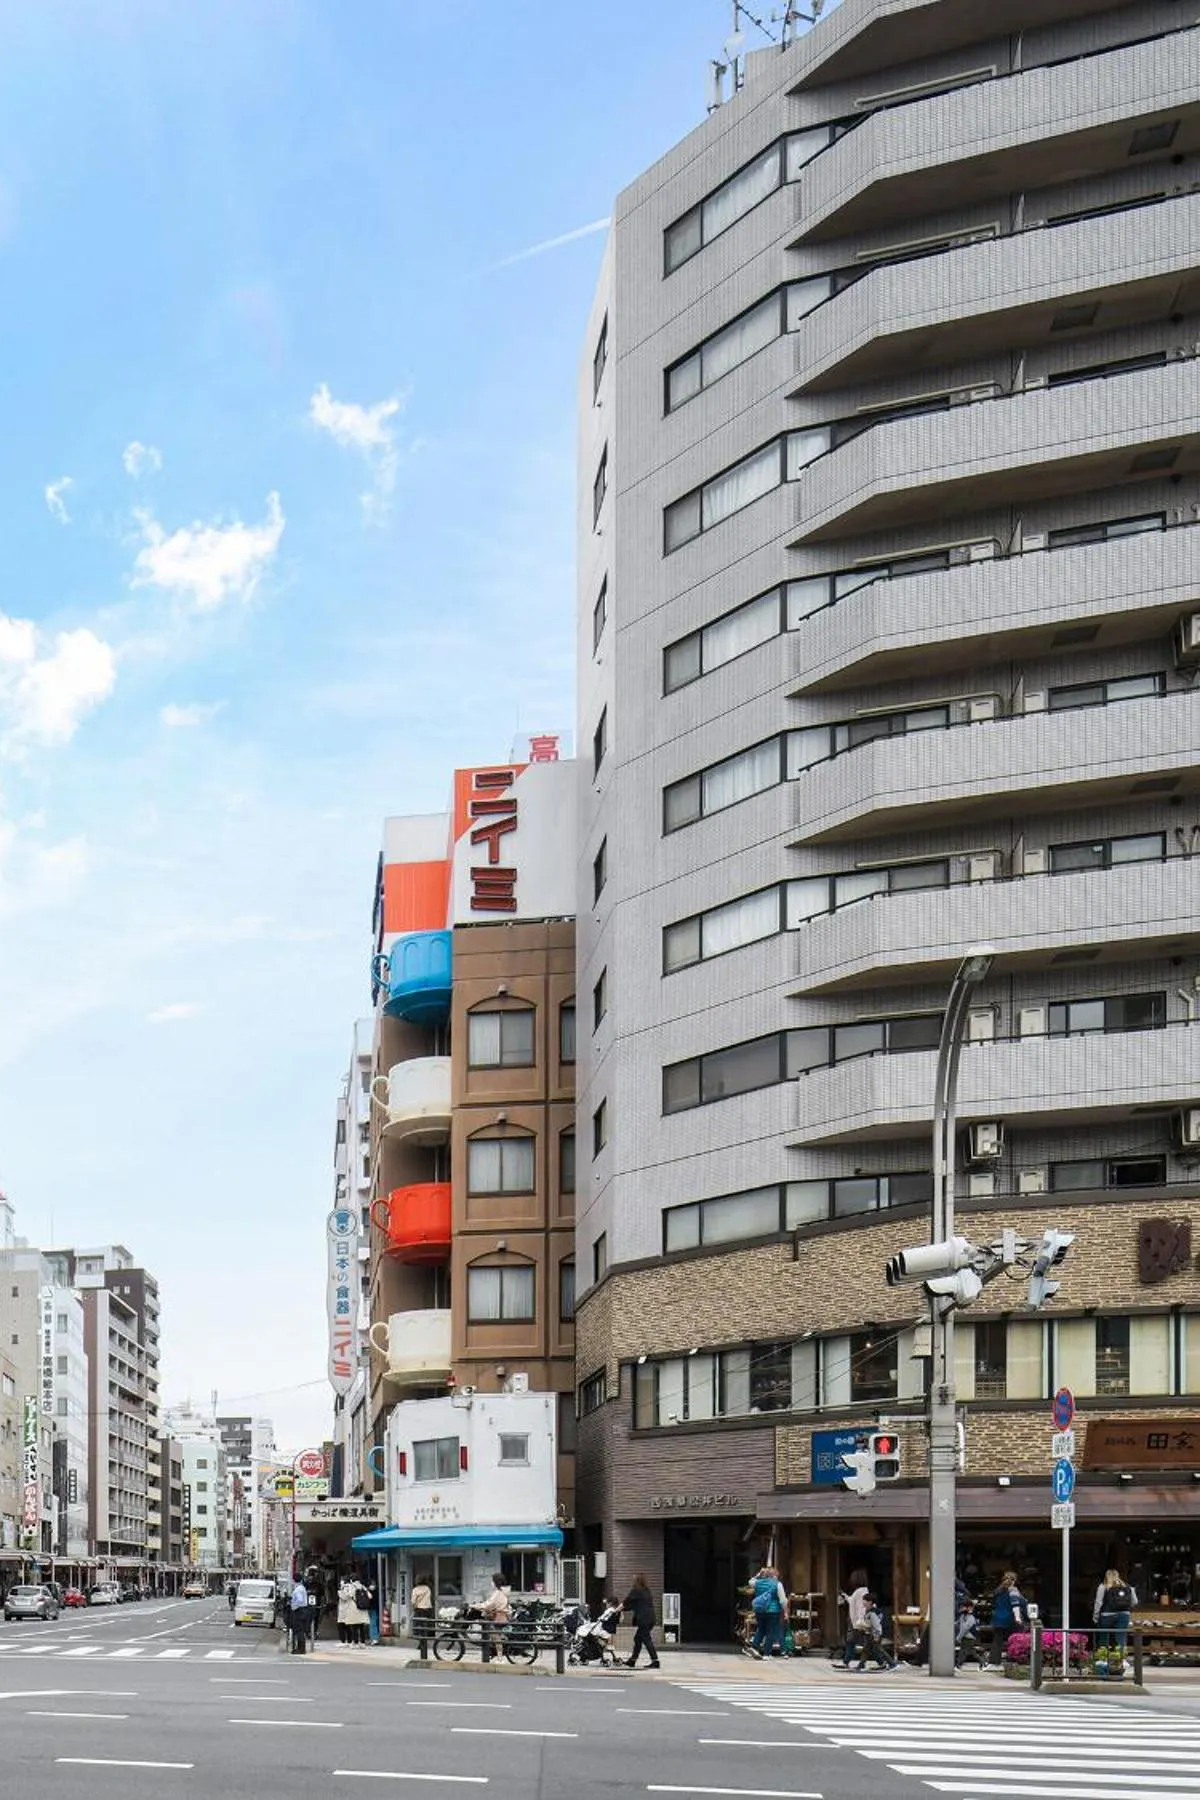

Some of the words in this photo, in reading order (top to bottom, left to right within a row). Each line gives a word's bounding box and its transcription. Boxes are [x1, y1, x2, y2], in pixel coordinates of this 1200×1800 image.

[470, 771, 518, 912] ニイミ
[335, 1240, 350, 1315] 日本の食器
[333, 1318, 351, 1379] ニイミ
